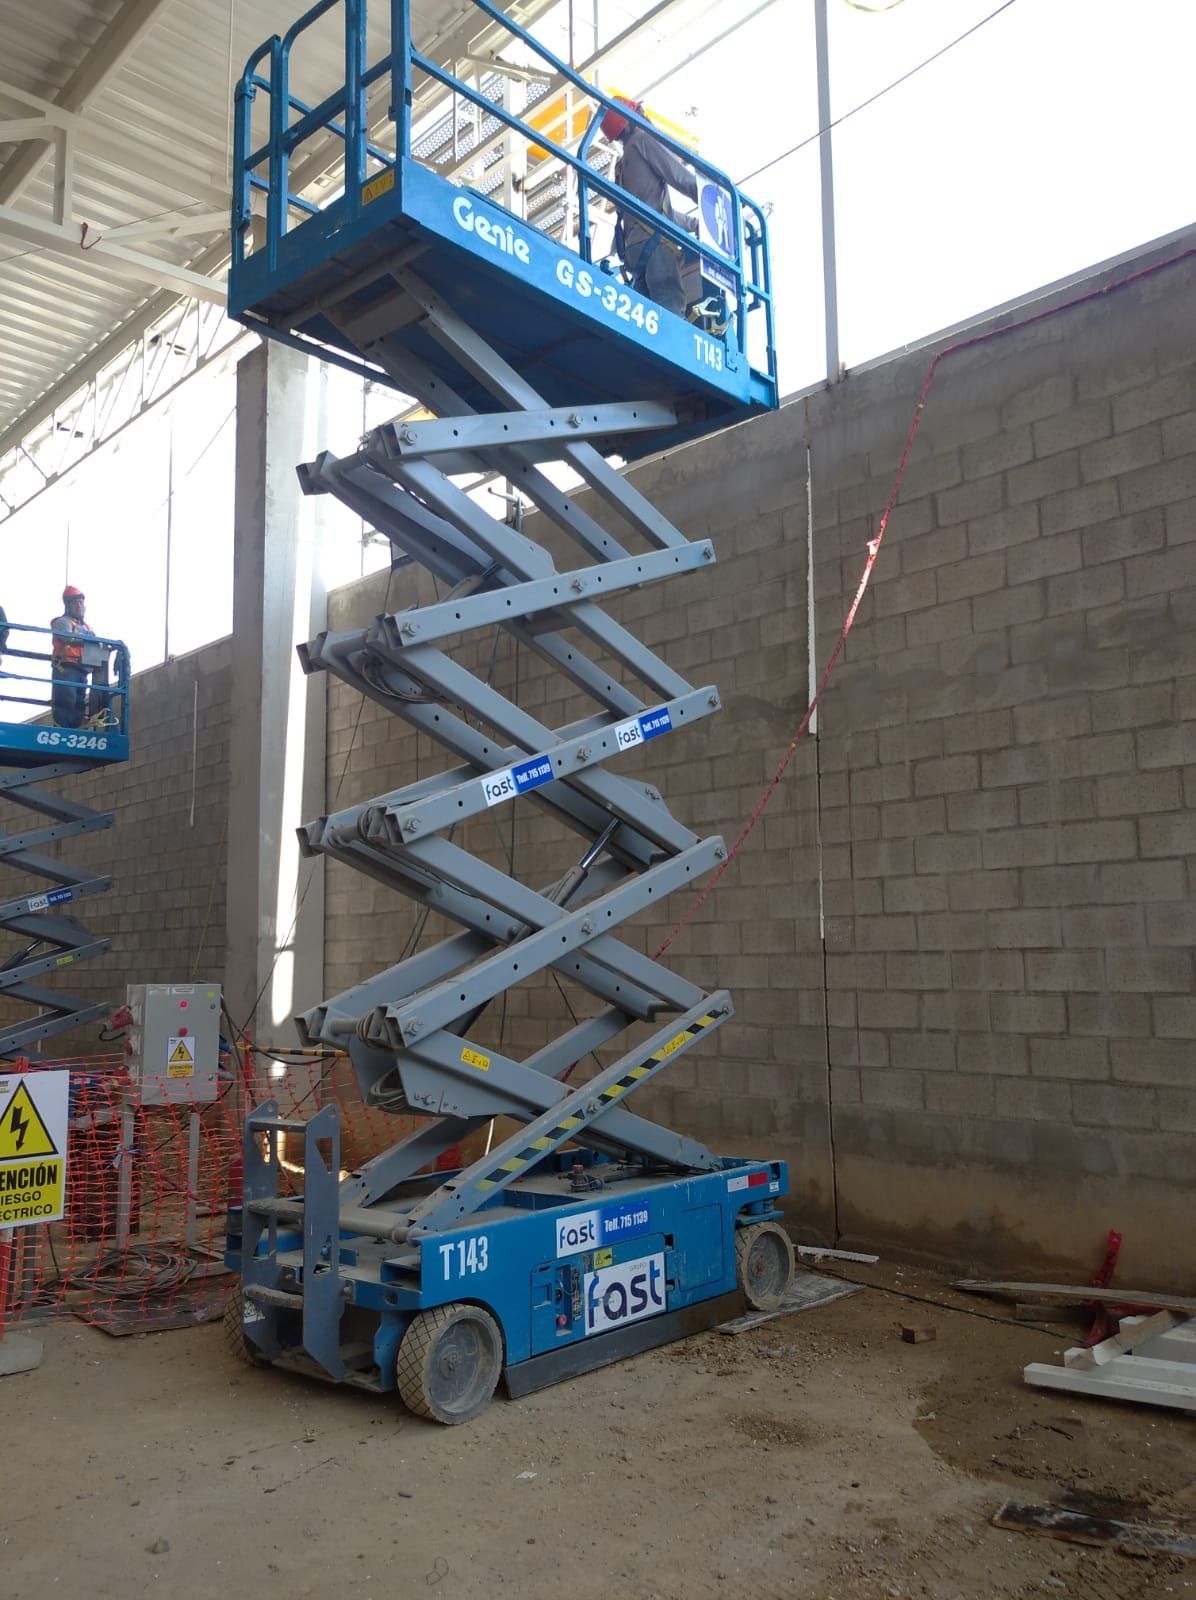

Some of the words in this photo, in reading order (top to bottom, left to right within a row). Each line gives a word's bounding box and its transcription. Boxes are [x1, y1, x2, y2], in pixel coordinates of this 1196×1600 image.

[453, 196, 530, 264] Genie
[556, 258, 659, 335] GS-3246
[694, 333, 723, 372] T143
[37, 731, 108, 750] GS-3246
[618, 724, 641, 746] fast
[486, 775, 514, 801] fast
[560, 1219, 595, 1249] fast
[620, 1214, 632, 1229] 715
[633, 1210, 648, 1226] 1139
[588, 1259, 663, 1328] fast
